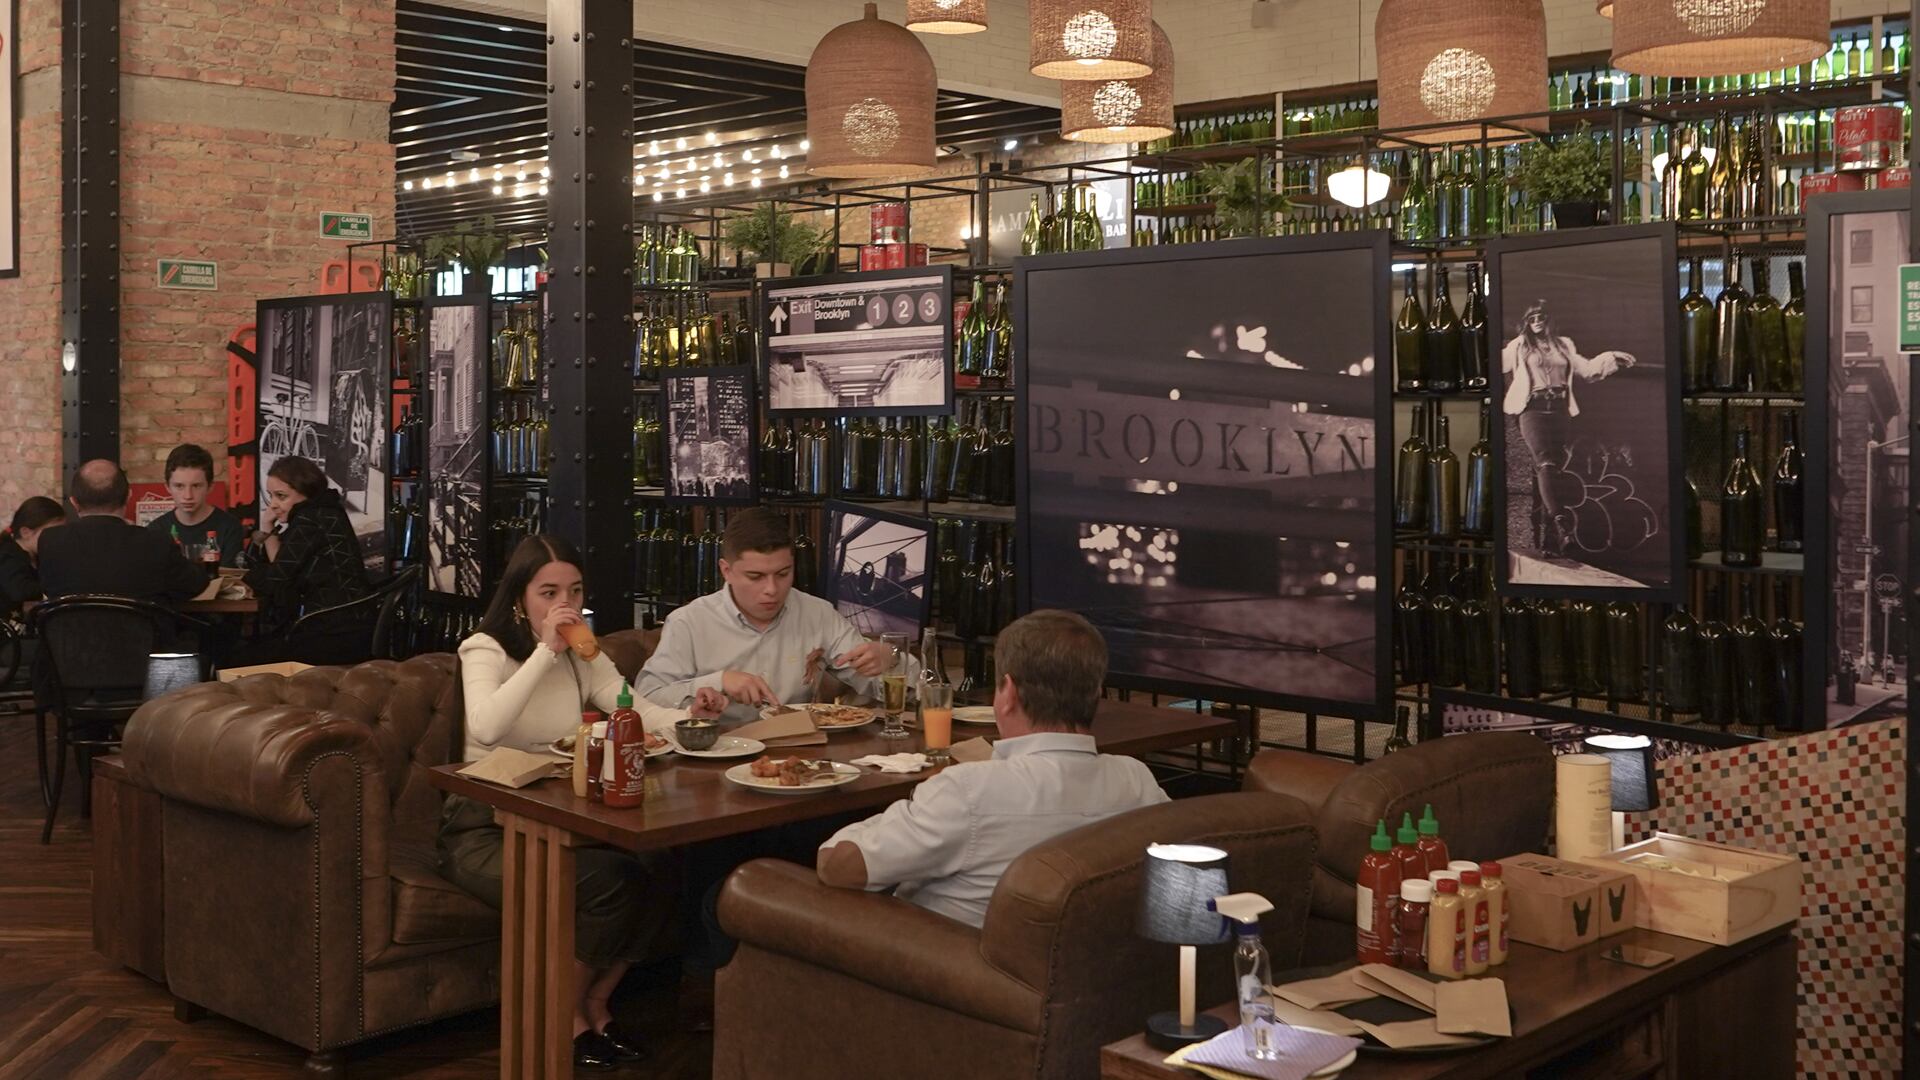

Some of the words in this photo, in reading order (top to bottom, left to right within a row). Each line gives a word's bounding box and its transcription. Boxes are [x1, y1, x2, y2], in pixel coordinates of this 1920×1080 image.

[1840, 111, 1867, 121] MUTTI
[1886, 171, 1911, 181] MUTT
[1804, 179, 1831, 189] MUTTI
[1105, 223, 1127, 238] BAR
[790, 301, 812, 315] Exit
[814, 298, 857, 310] Downtown
[858, 295, 865, 307] &
[872, 302, 881, 320] 1
[898, 300, 909, 319] 2
[924, 298, 935, 317] 3
[814, 308, 851, 321] Brooklyn
[1032, 404, 1369, 482] BROOKLYN
[1876, 580, 1899, 592] STOP
